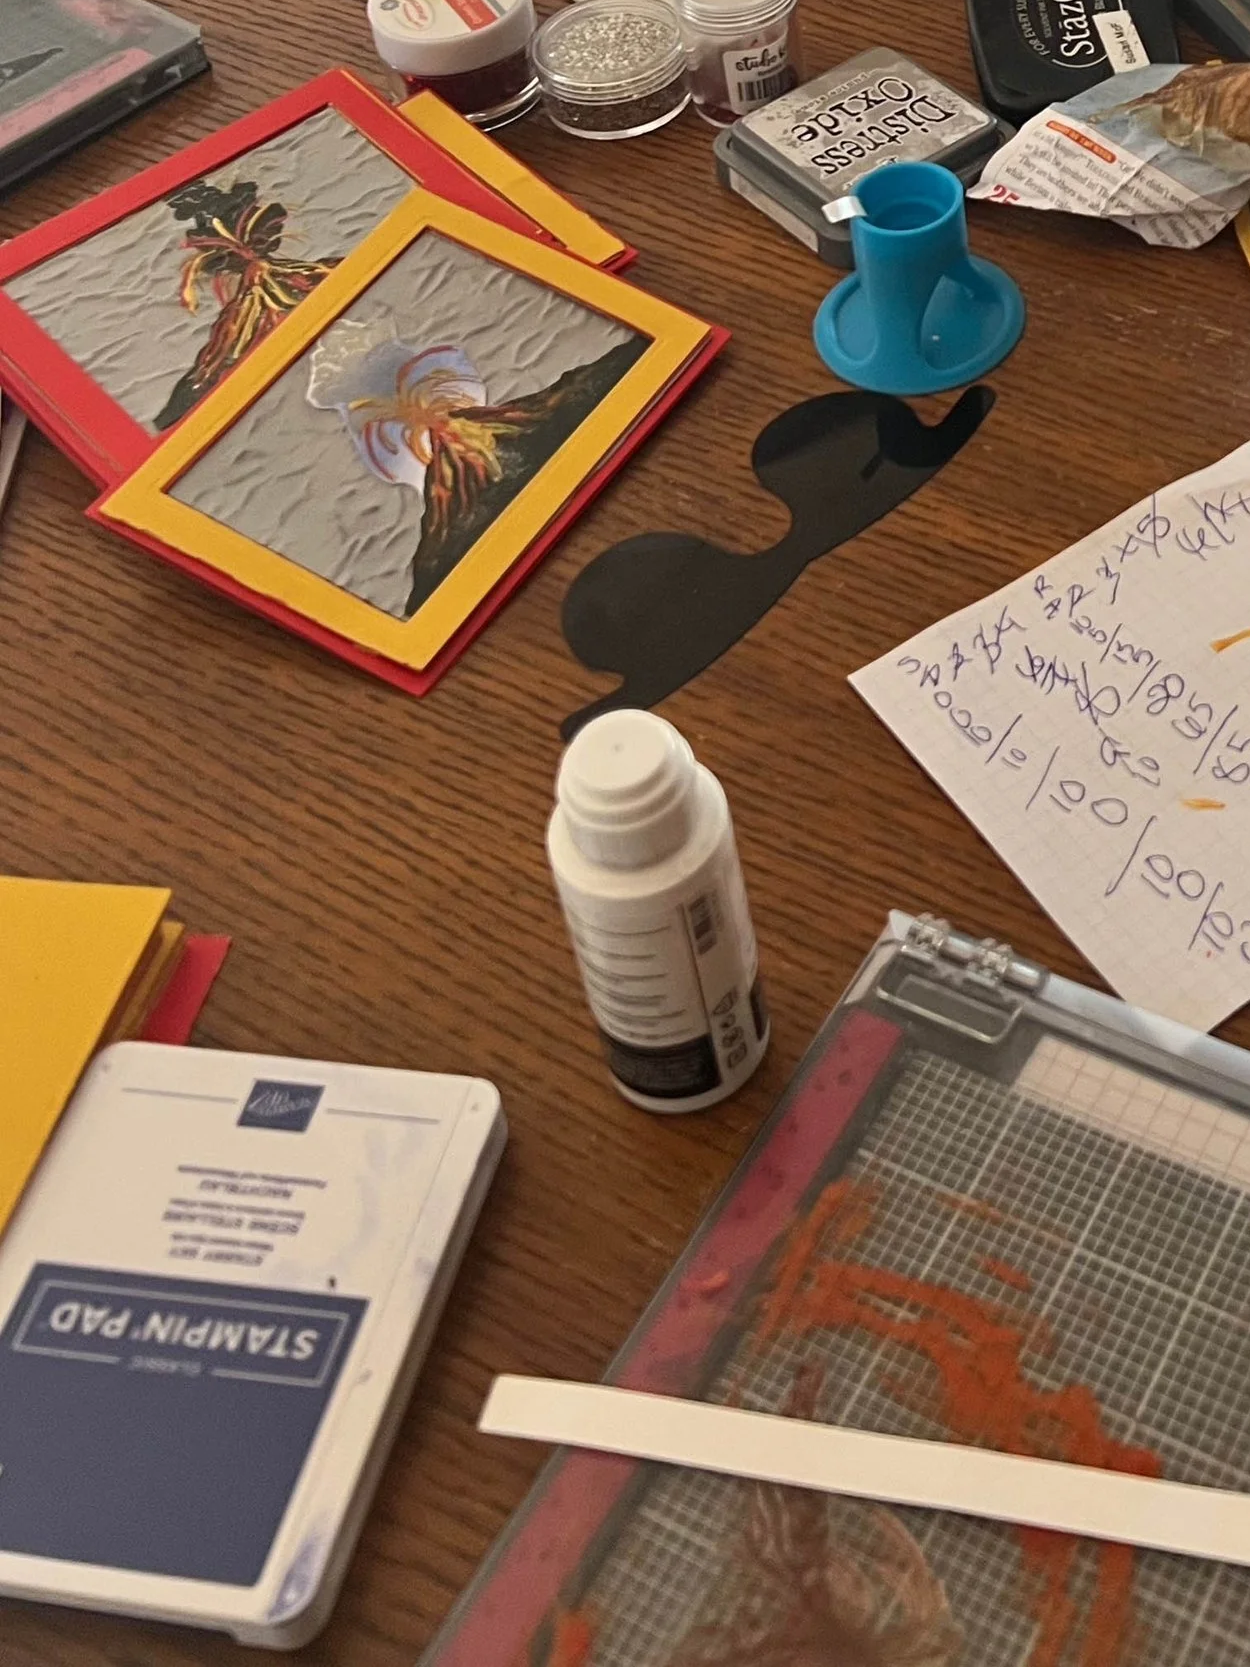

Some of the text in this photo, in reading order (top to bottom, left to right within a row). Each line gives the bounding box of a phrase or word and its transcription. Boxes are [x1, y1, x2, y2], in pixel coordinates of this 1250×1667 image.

[790, 77, 914, 143] Oxide
[810, 95, 958, 175] Distress
[48, 1300, 322, 1362] STAMPIN' PAD
